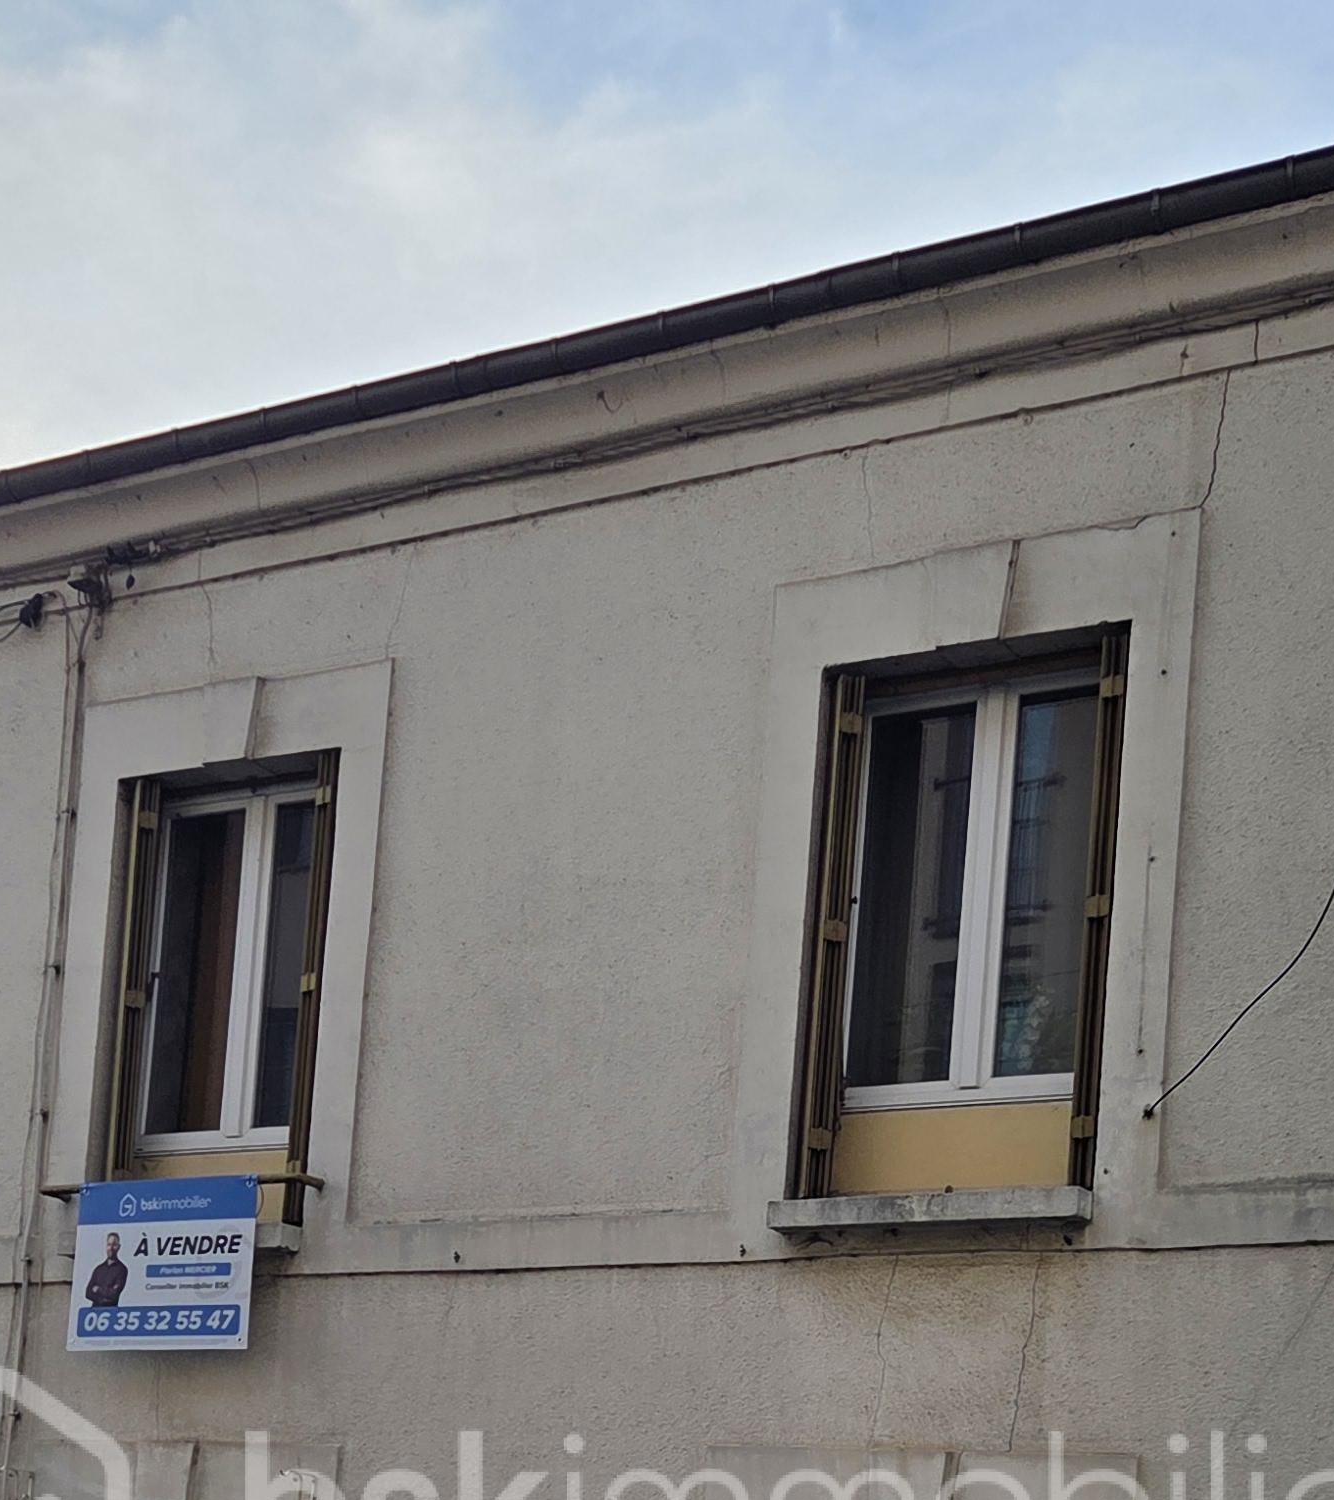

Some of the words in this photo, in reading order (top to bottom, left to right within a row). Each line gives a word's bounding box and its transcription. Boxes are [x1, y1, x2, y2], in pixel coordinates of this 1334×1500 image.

[140, 1196, 212, 1211] bskimmobilier
[133, 1231, 149, 1257] À
[156, 1234, 243, 1256] VENDRE
[84, 1311, 111, 1332] 06
[113, 1311, 141, 1330] 35
[144, 1310, 171, 1330] 32
[174, 1310, 203, 1330] 55
[206, 1309, 236, 1329] 47
